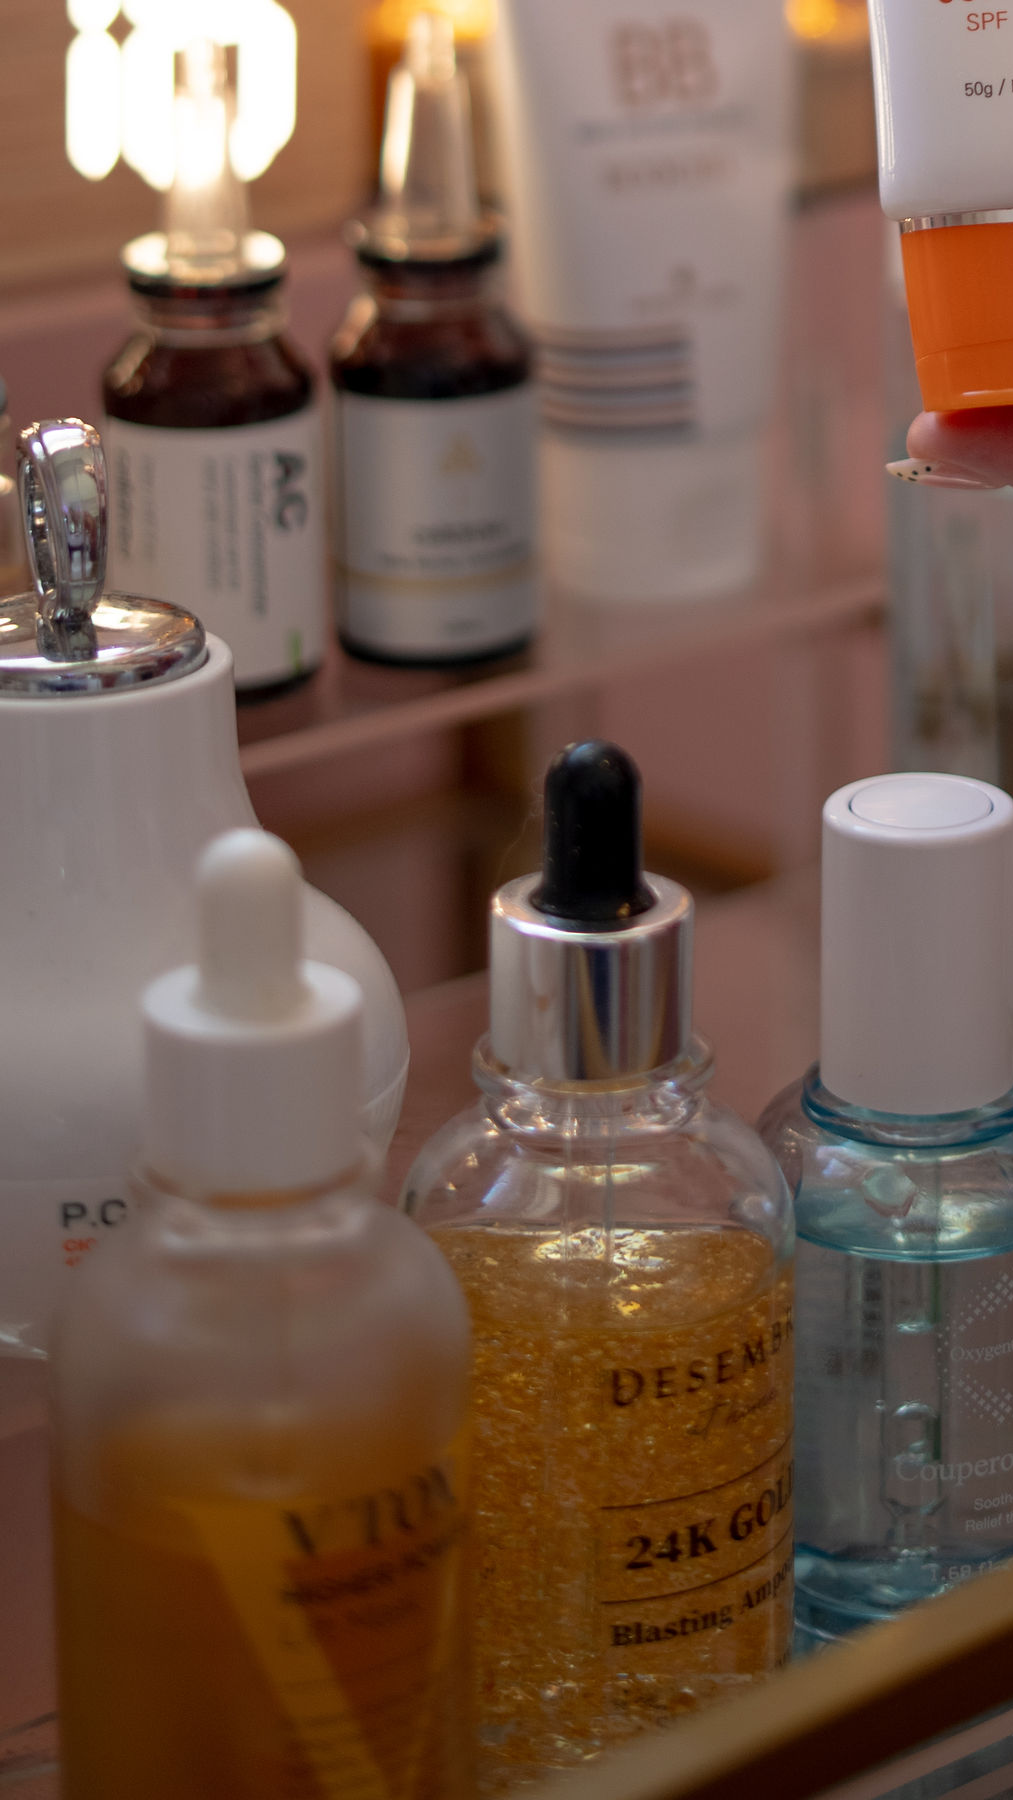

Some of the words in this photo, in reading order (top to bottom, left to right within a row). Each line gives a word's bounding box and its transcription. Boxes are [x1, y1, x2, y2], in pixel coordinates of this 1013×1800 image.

[966, 11, 1009, 32] SPF
[964, 81, 993, 98] 50g
[998, 78, 1006, 96] /
[611, 1320, 794, 1407] DESEMBR
[965, 1513, 1003, 1533] Relief
[626, 1518, 718, 1570] 24K
[610, 1604, 735, 1647] Blasting
